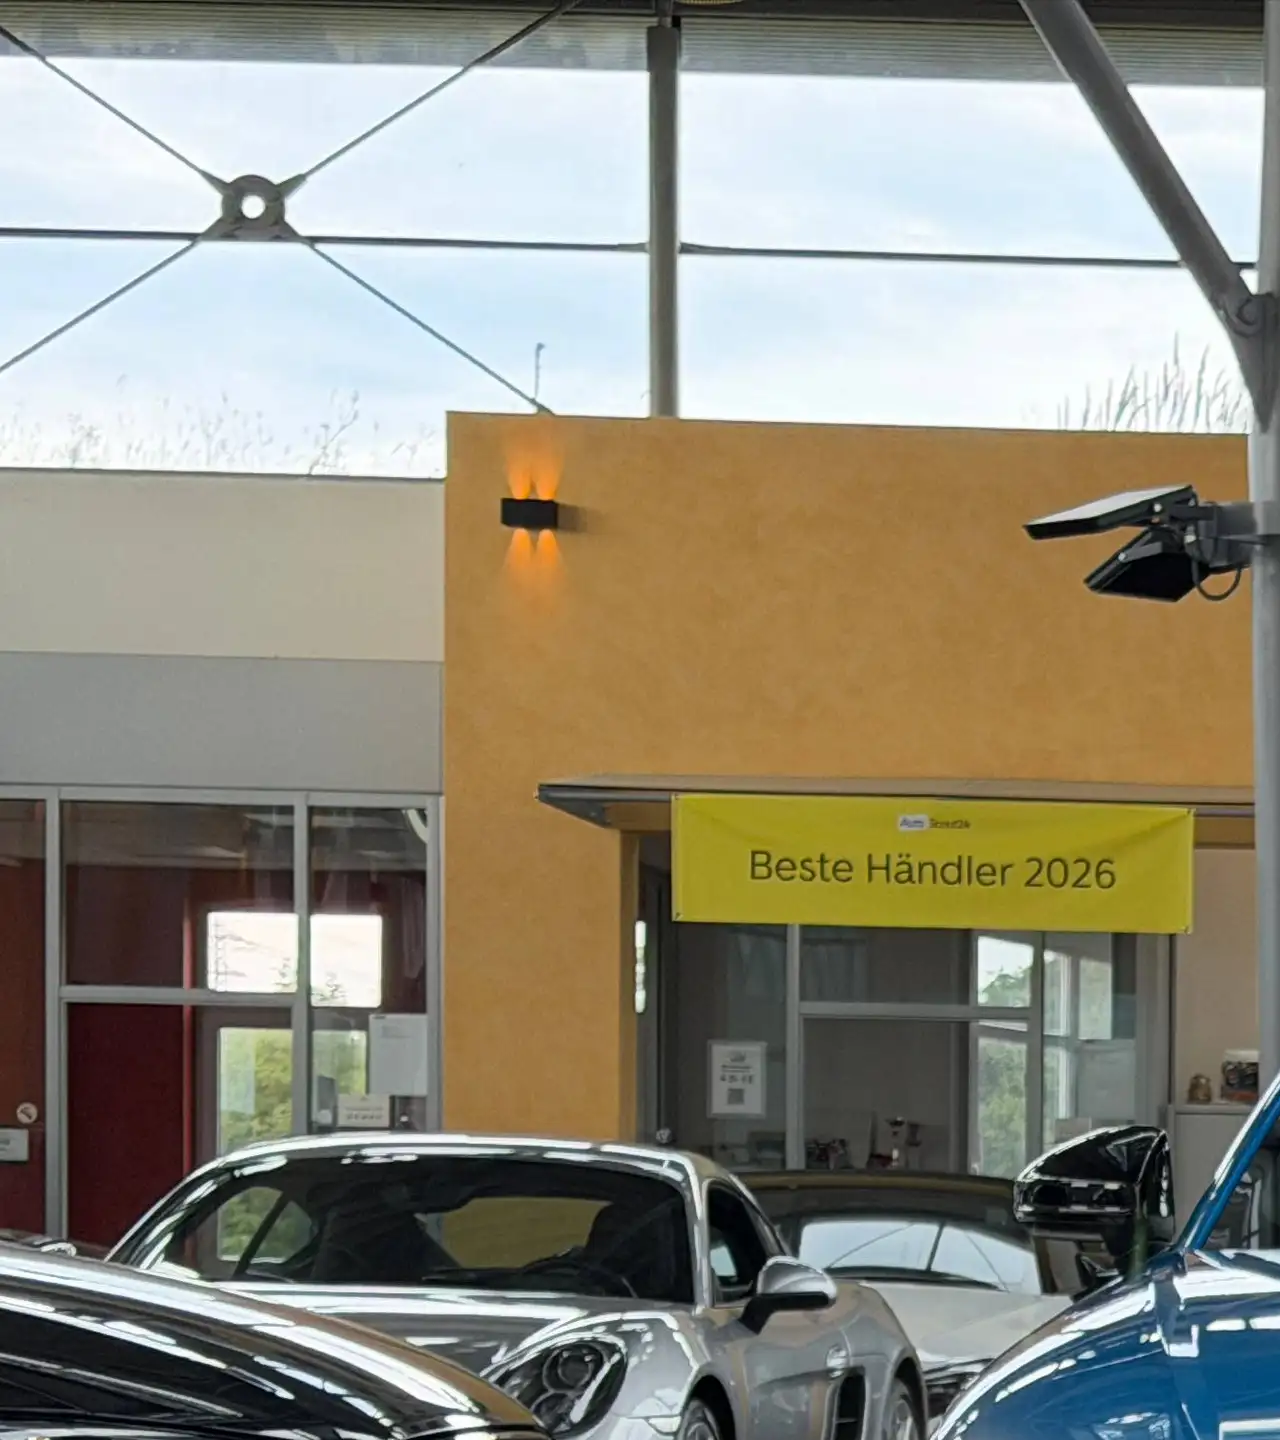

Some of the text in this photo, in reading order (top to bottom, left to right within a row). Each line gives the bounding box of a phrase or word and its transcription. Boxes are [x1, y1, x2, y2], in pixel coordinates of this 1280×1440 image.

[750, 850, 1117, 890] Beste Händler 2026
